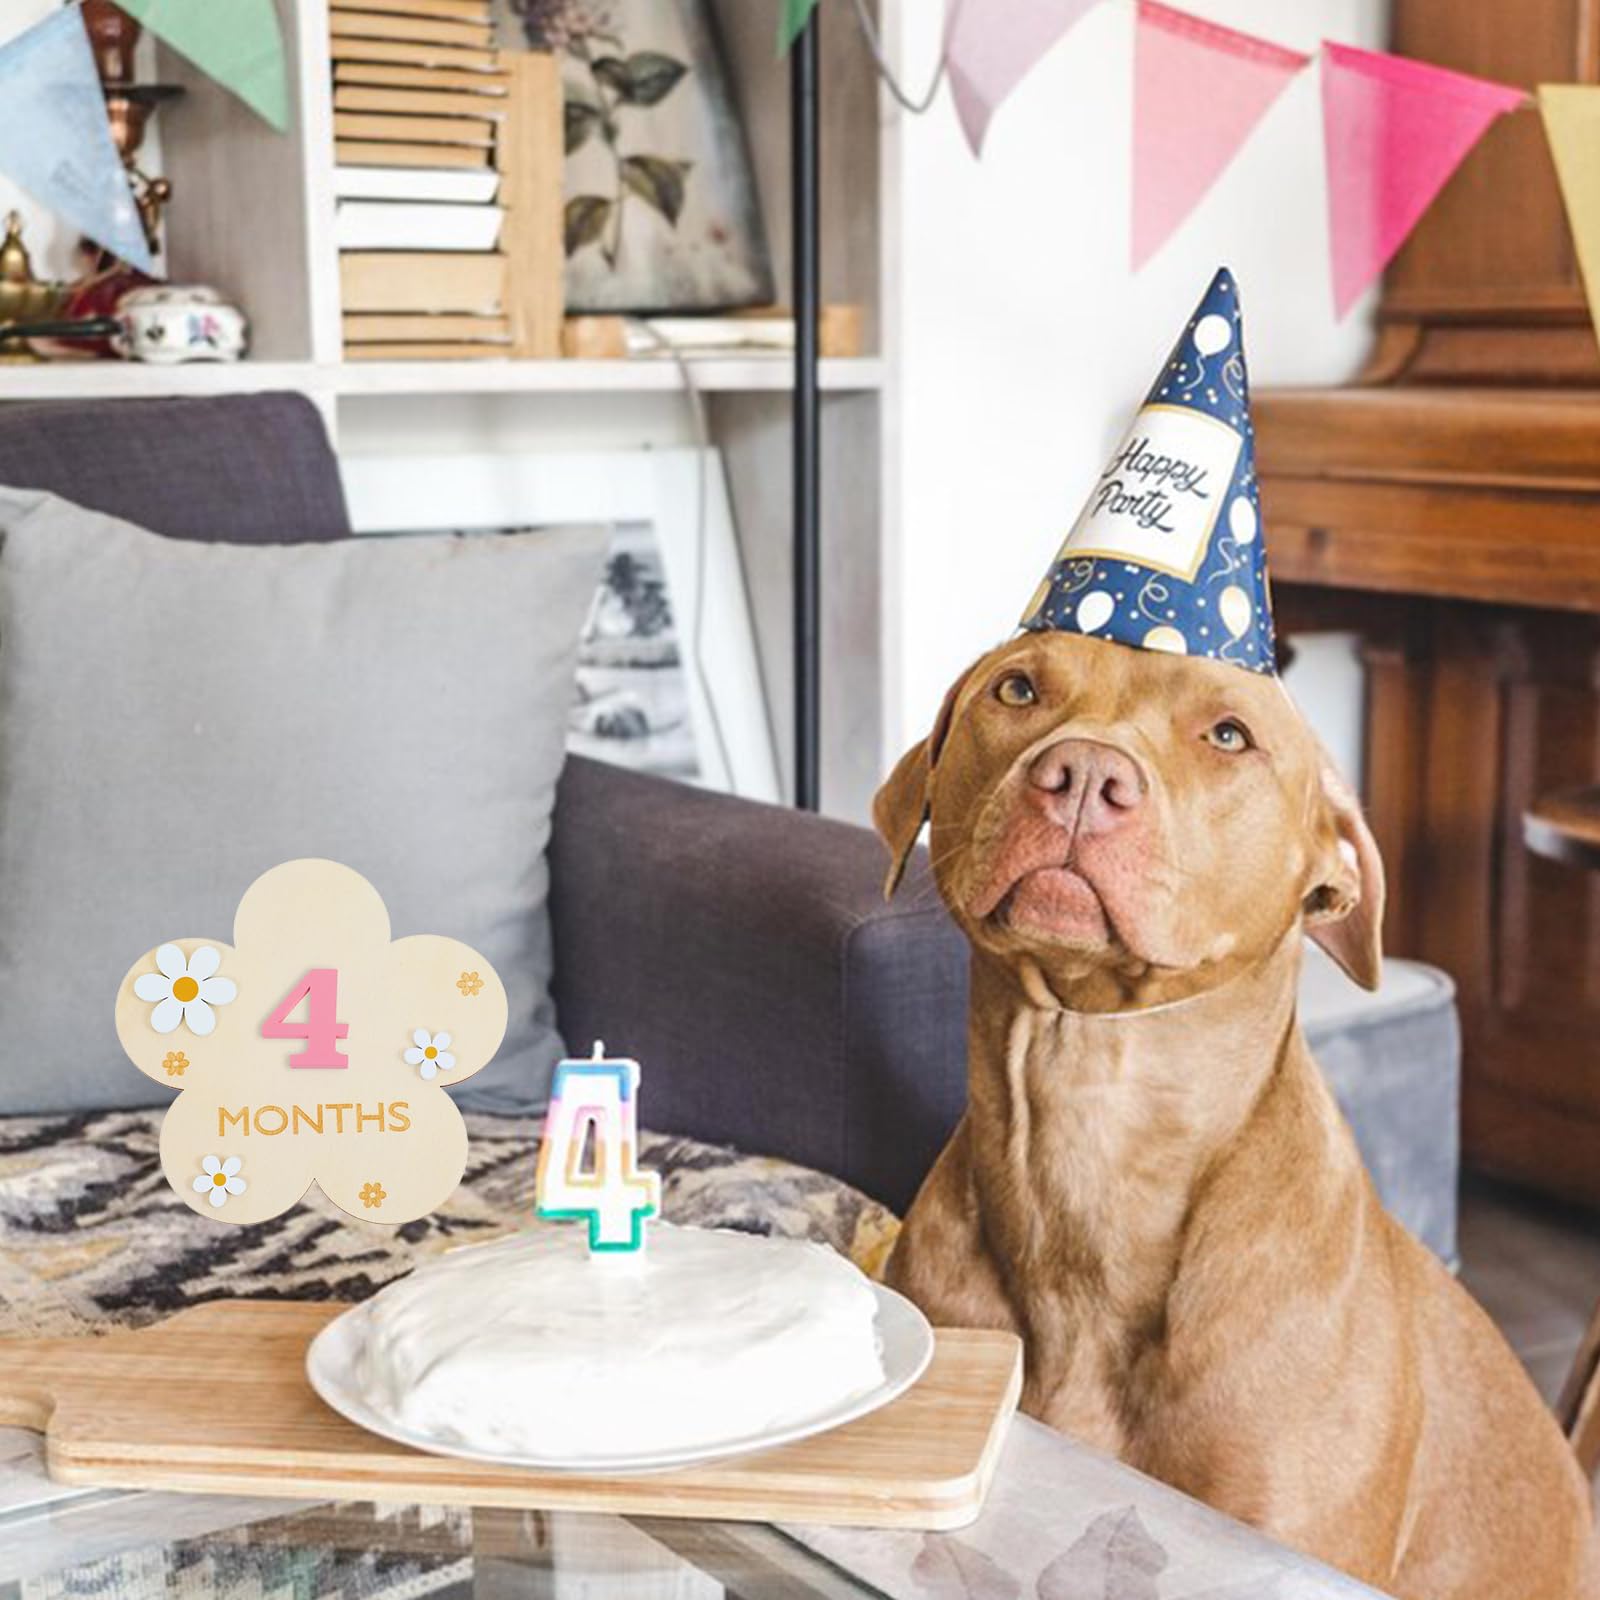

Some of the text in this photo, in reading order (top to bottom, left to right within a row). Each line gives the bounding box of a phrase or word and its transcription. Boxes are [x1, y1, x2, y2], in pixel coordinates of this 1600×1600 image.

[1102, 438, 1208, 498] Happy
[1091, 480, 1174, 533] Party
[261, 968, 349, 1069] 4
[217, 1101, 411, 1137] MONTHS
[536, 1058, 661, 1252] 4
